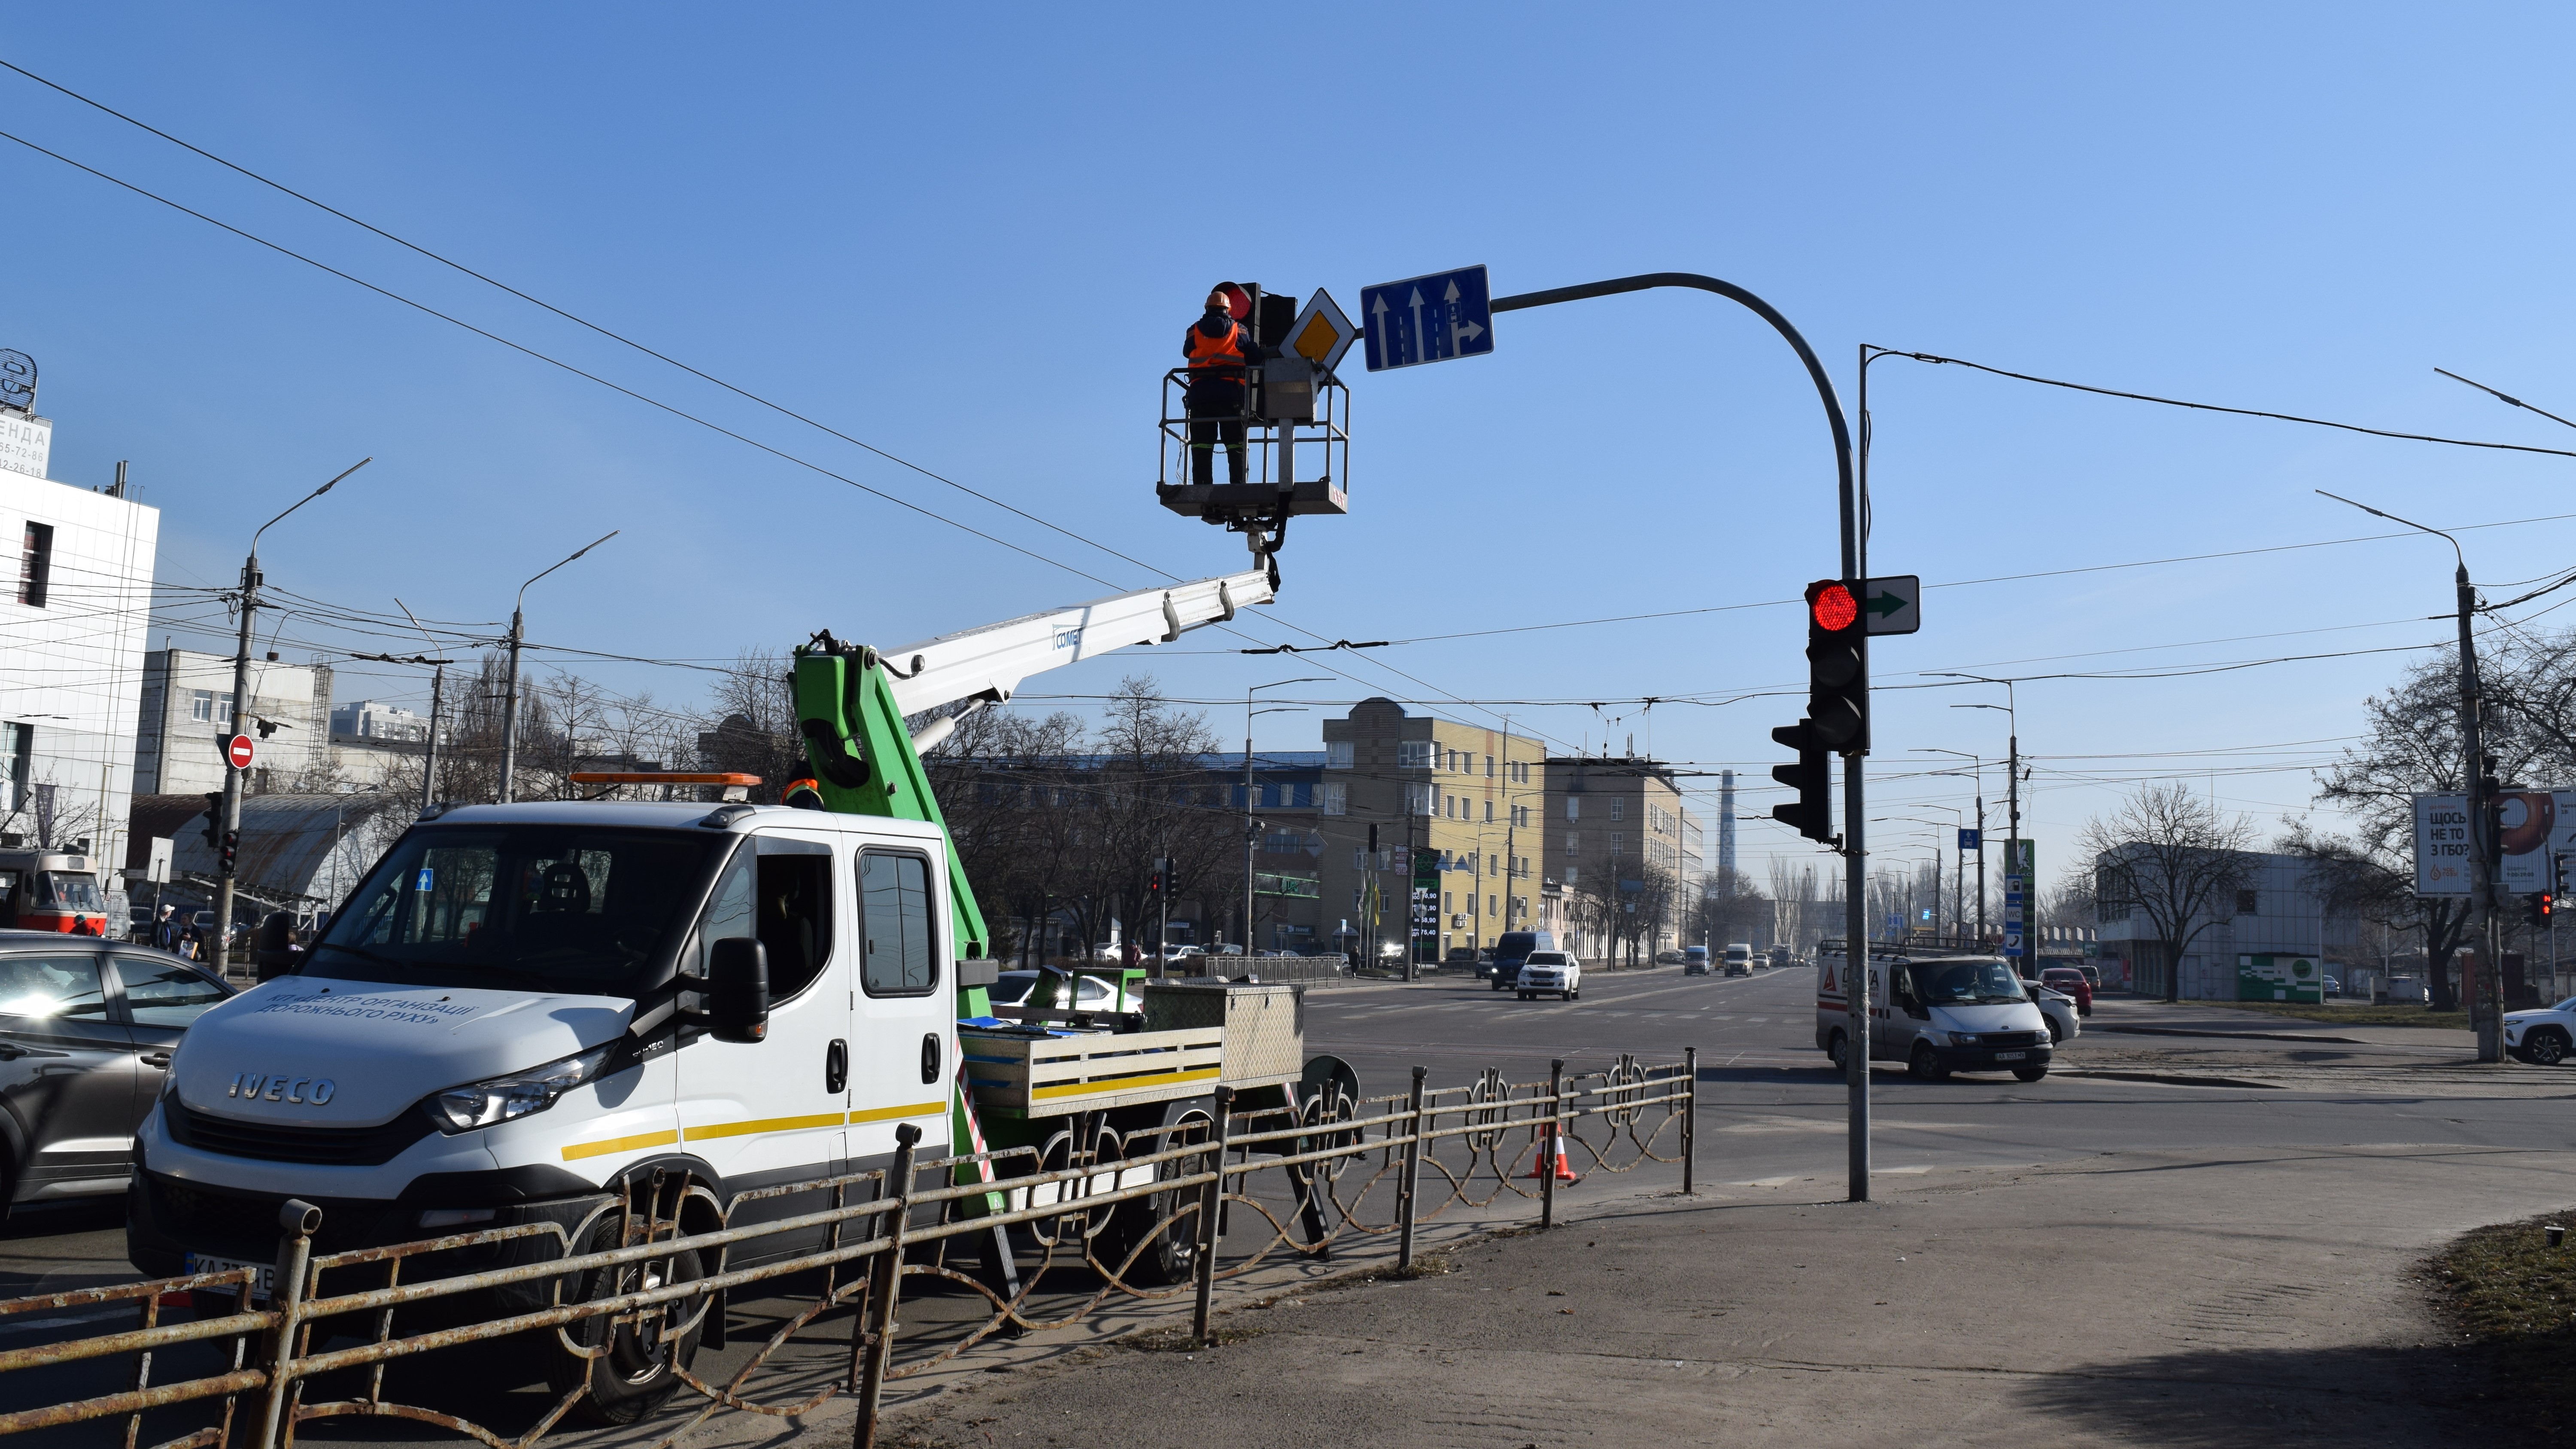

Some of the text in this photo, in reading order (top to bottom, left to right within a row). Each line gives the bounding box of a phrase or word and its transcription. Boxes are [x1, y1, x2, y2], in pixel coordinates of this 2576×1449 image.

[2430, 812, 2467, 826] ЩОСЬ
[2430, 828, 2464, 840] НЕ ТО
[2441, 844, 2469, 856] ГБО?
[267, 994, 480, 1016] КП «ЦЕНТР ОРГАНІЗАЦІЇ
[254, 1004, 439, 1025] ДОРОЖНЬОГО РУХУ»
[229, 1072, 336, 1106] IVECO
